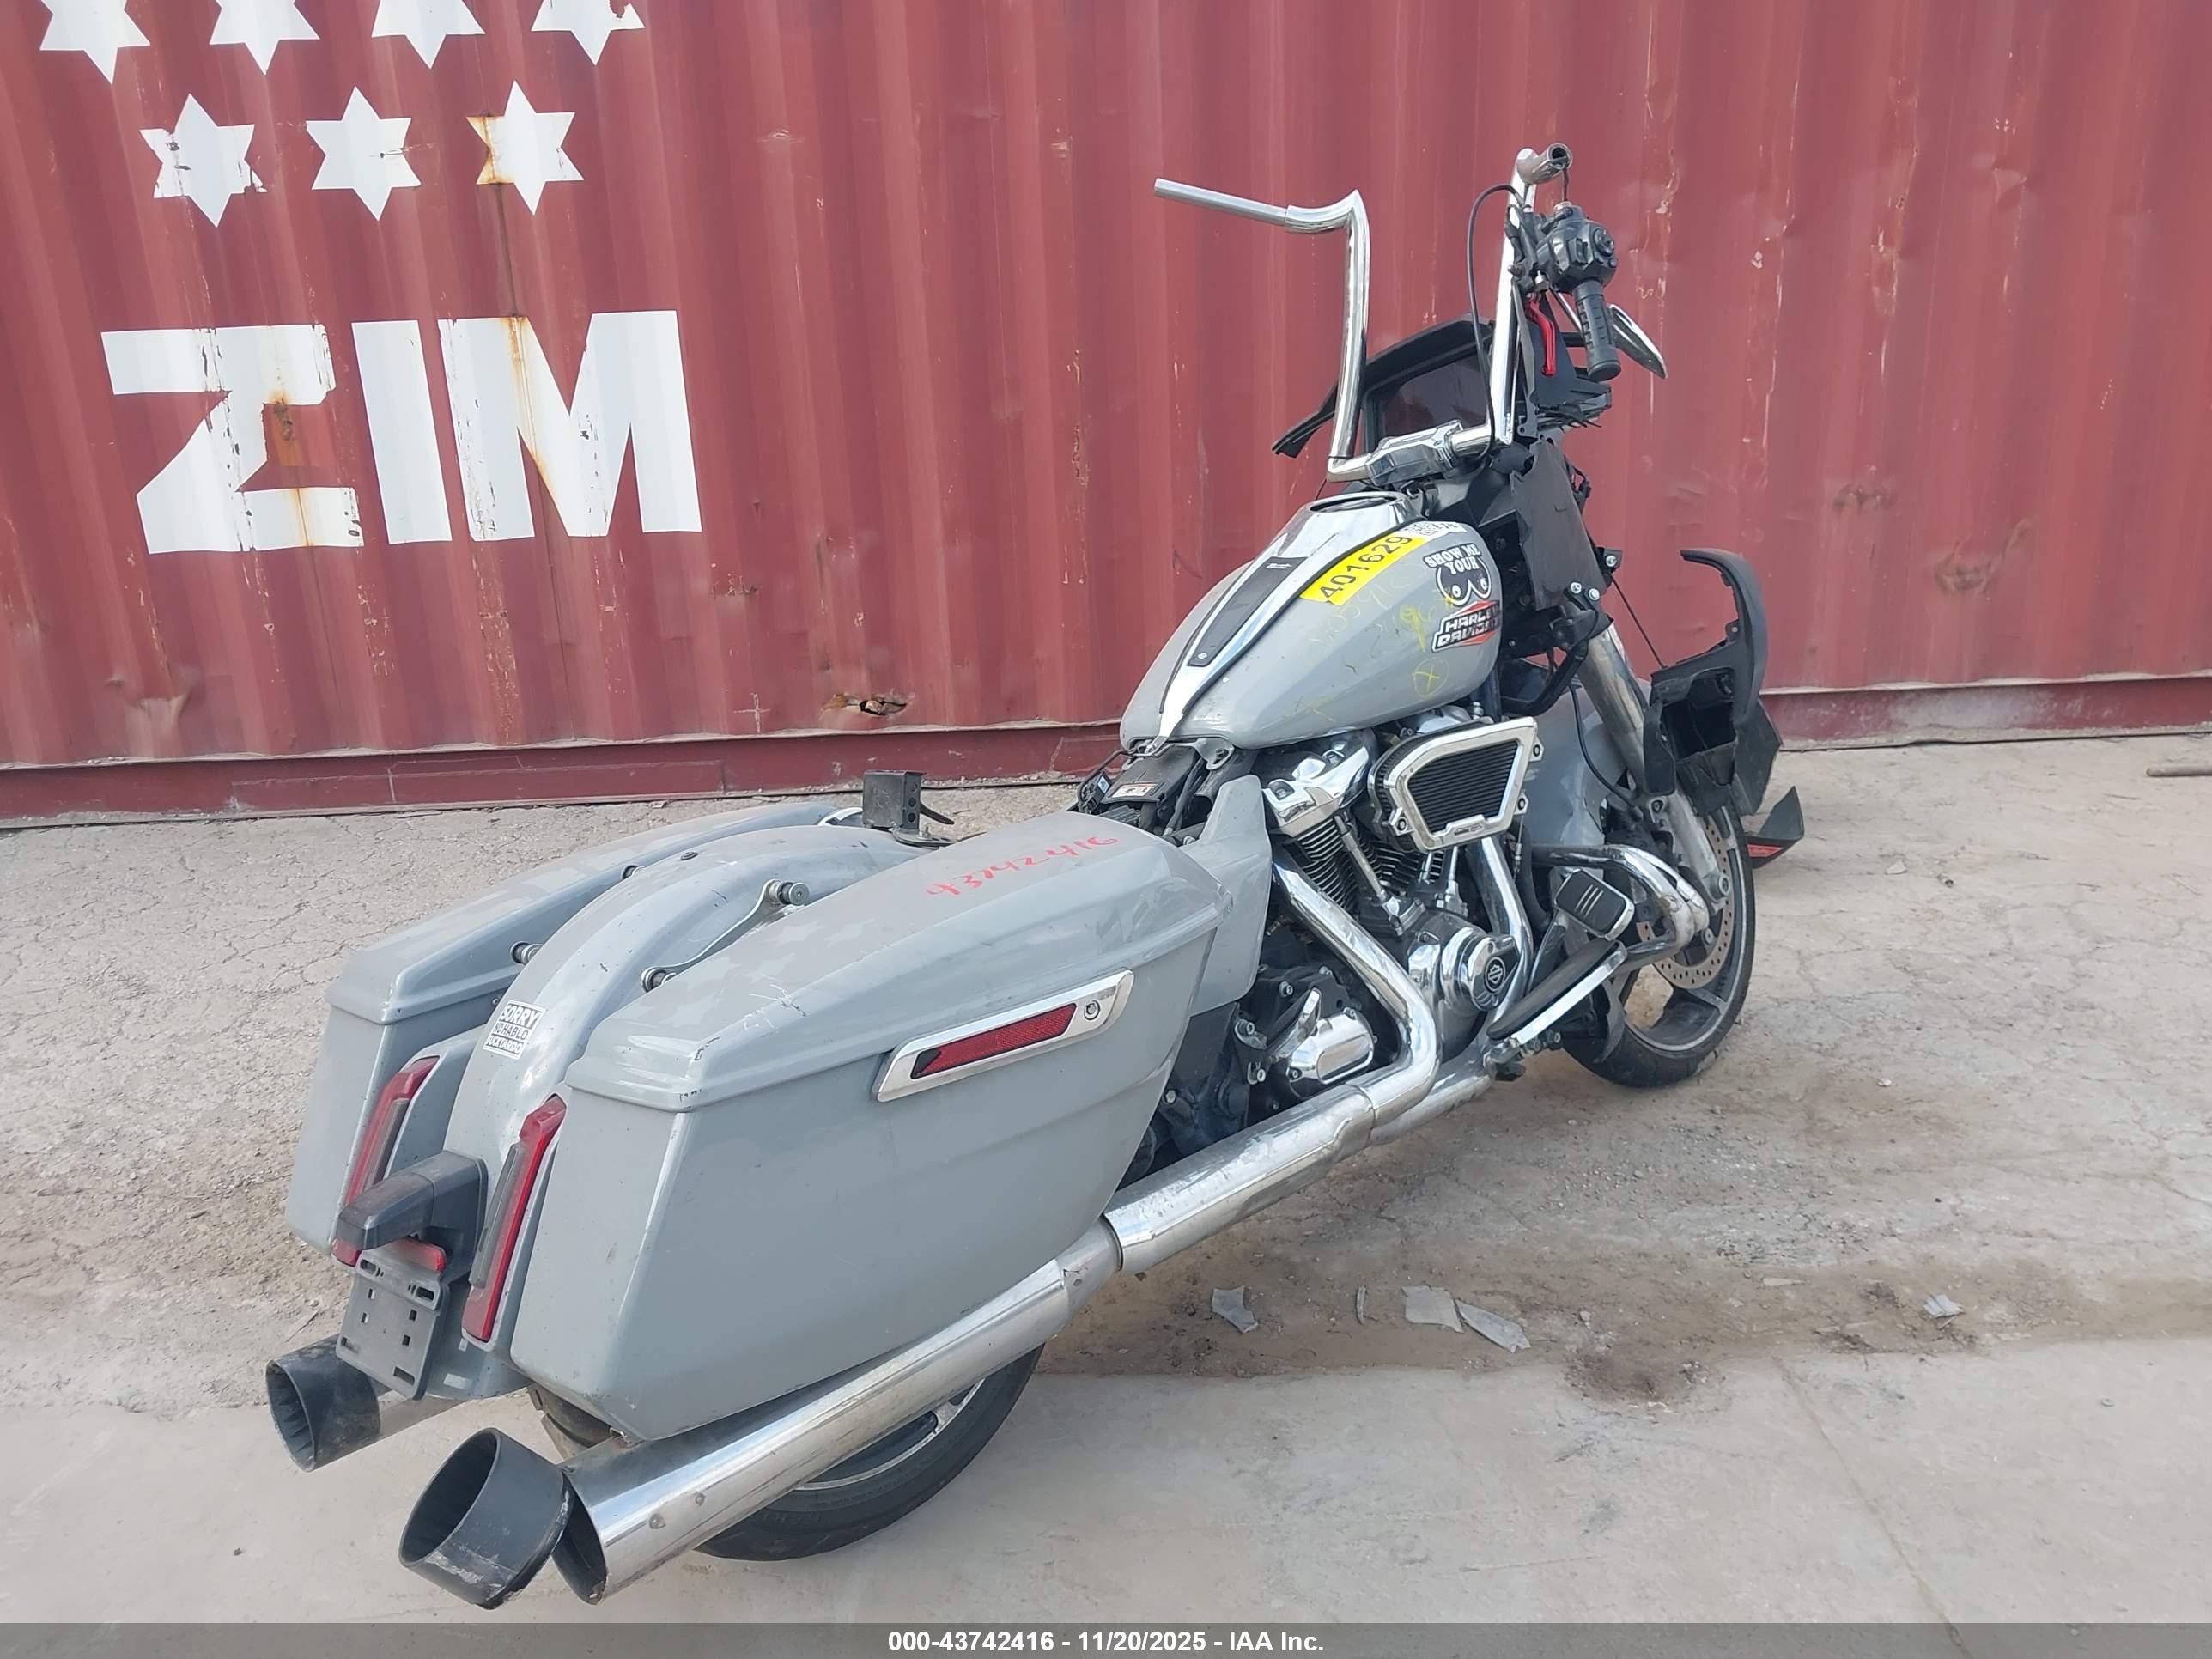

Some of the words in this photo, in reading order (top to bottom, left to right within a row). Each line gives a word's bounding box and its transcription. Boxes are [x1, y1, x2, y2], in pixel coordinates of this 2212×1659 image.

[101, 310, 702, 554] ZIM
[1318, 534, 1413, 599] 401629
[1425, 547, 1462, 568] SHOW
[1462, 544, 1481, 557] ME
[1444, 556, 1480, 574] YOUR
[500, 1004, 540, 1028] SORRY
[494, 1022, 502, 1033] NO
[501, 1024, 529, 1041] HABLO
